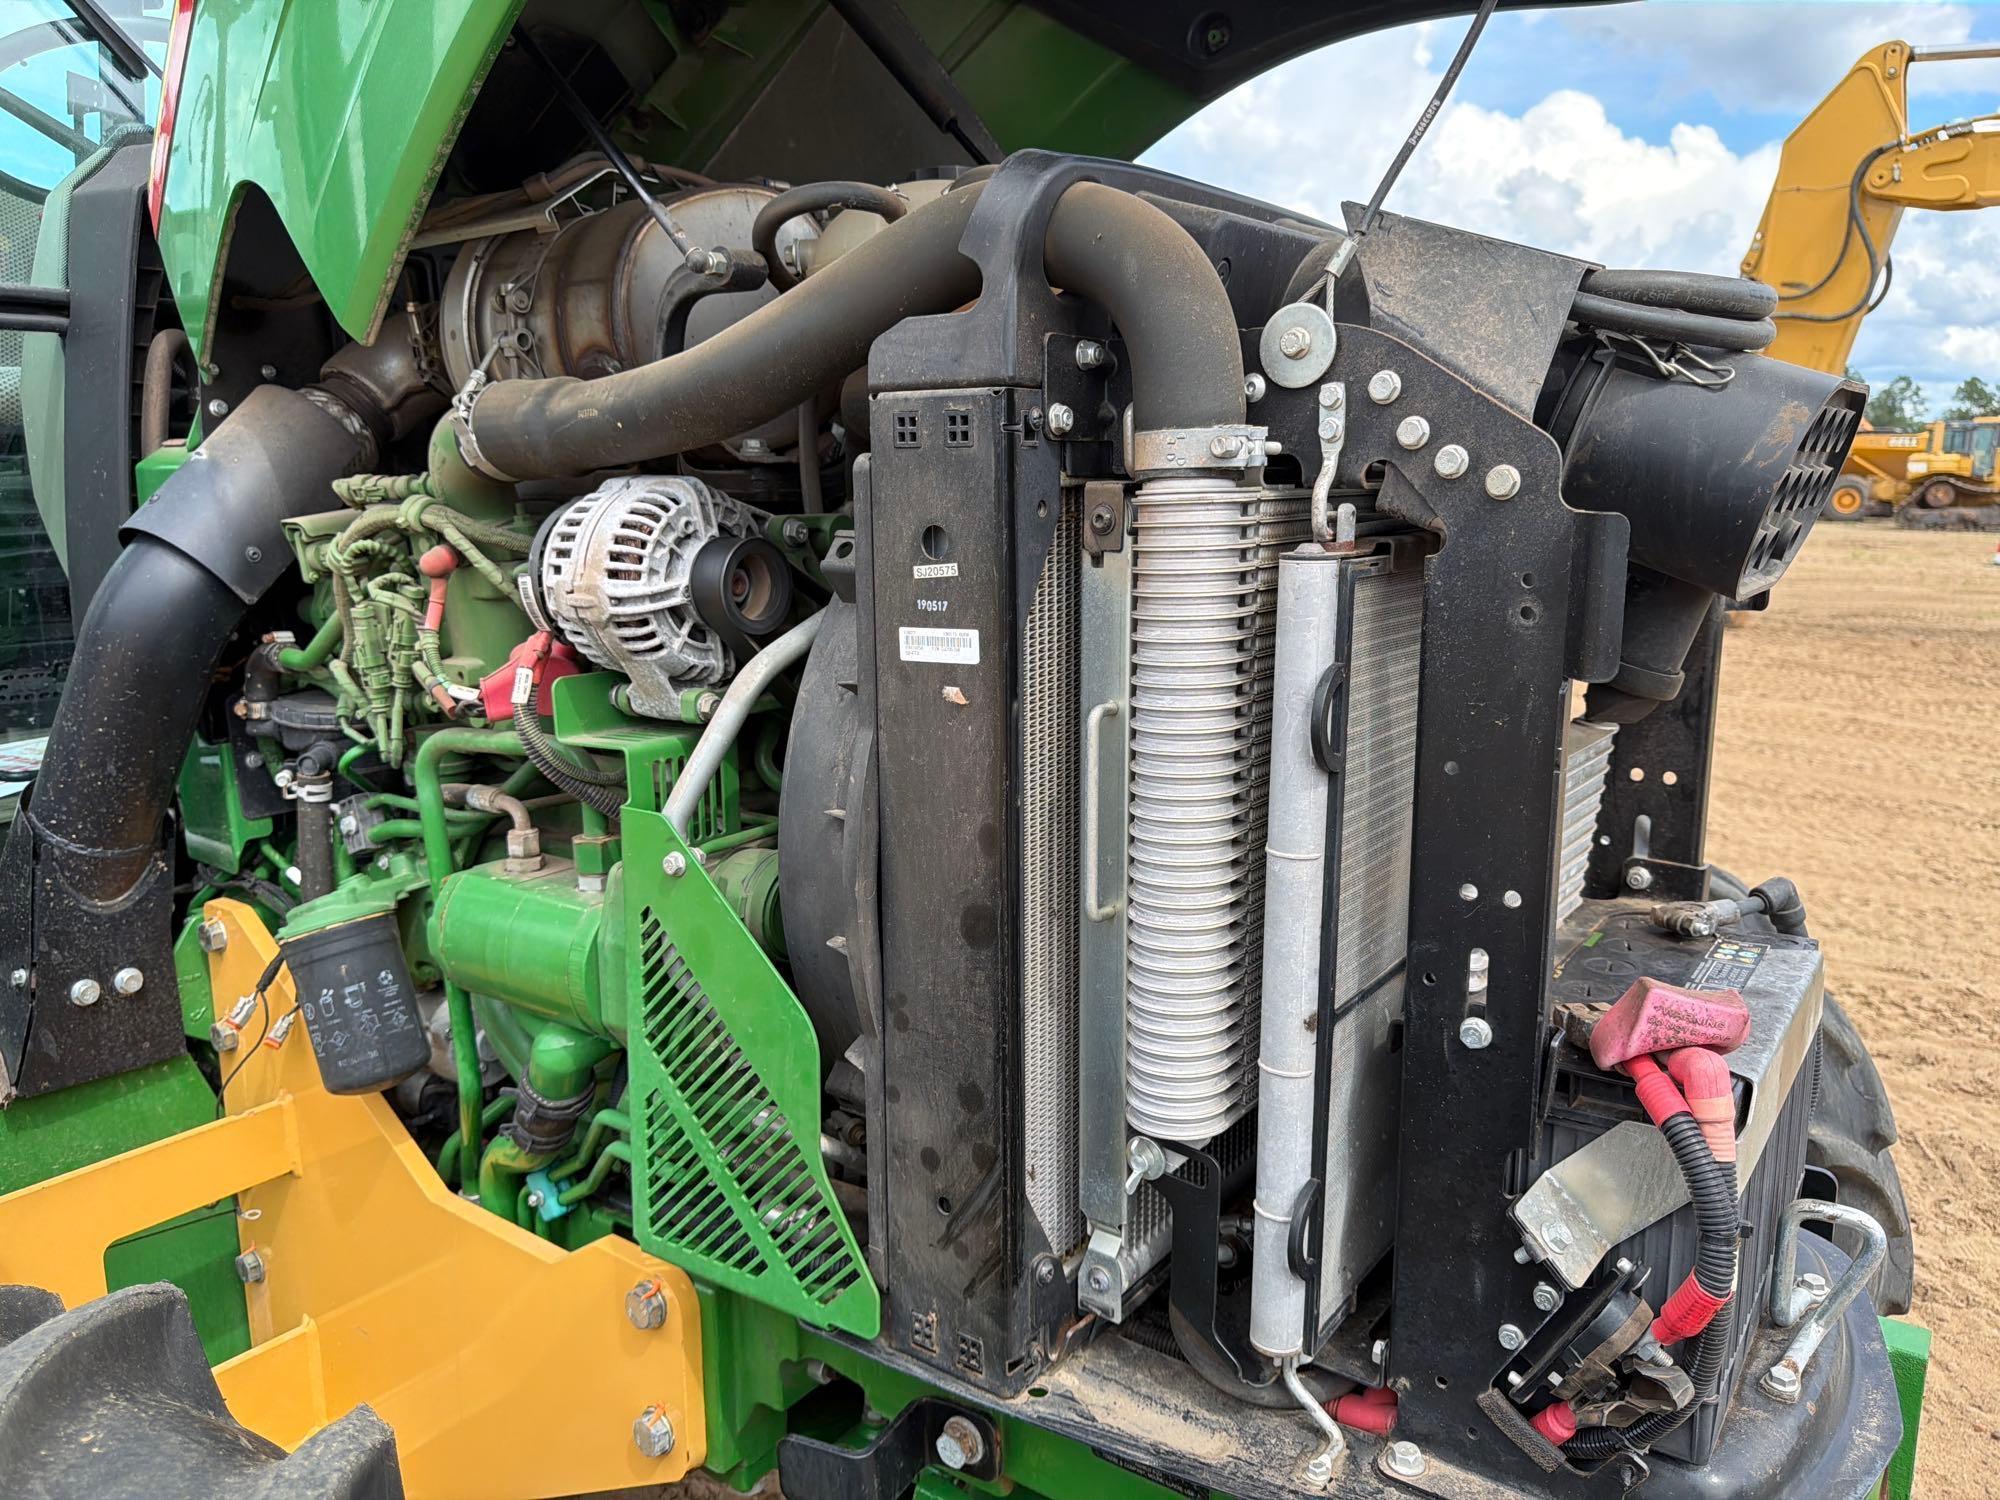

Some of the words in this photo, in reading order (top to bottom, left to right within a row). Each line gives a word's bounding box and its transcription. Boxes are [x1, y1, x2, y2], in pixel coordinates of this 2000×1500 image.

[916, 565, 957, 577] SJ20575
[917, 599, 948, 612] 190517
[1663, 1007, 1726, 1029] WARNING
